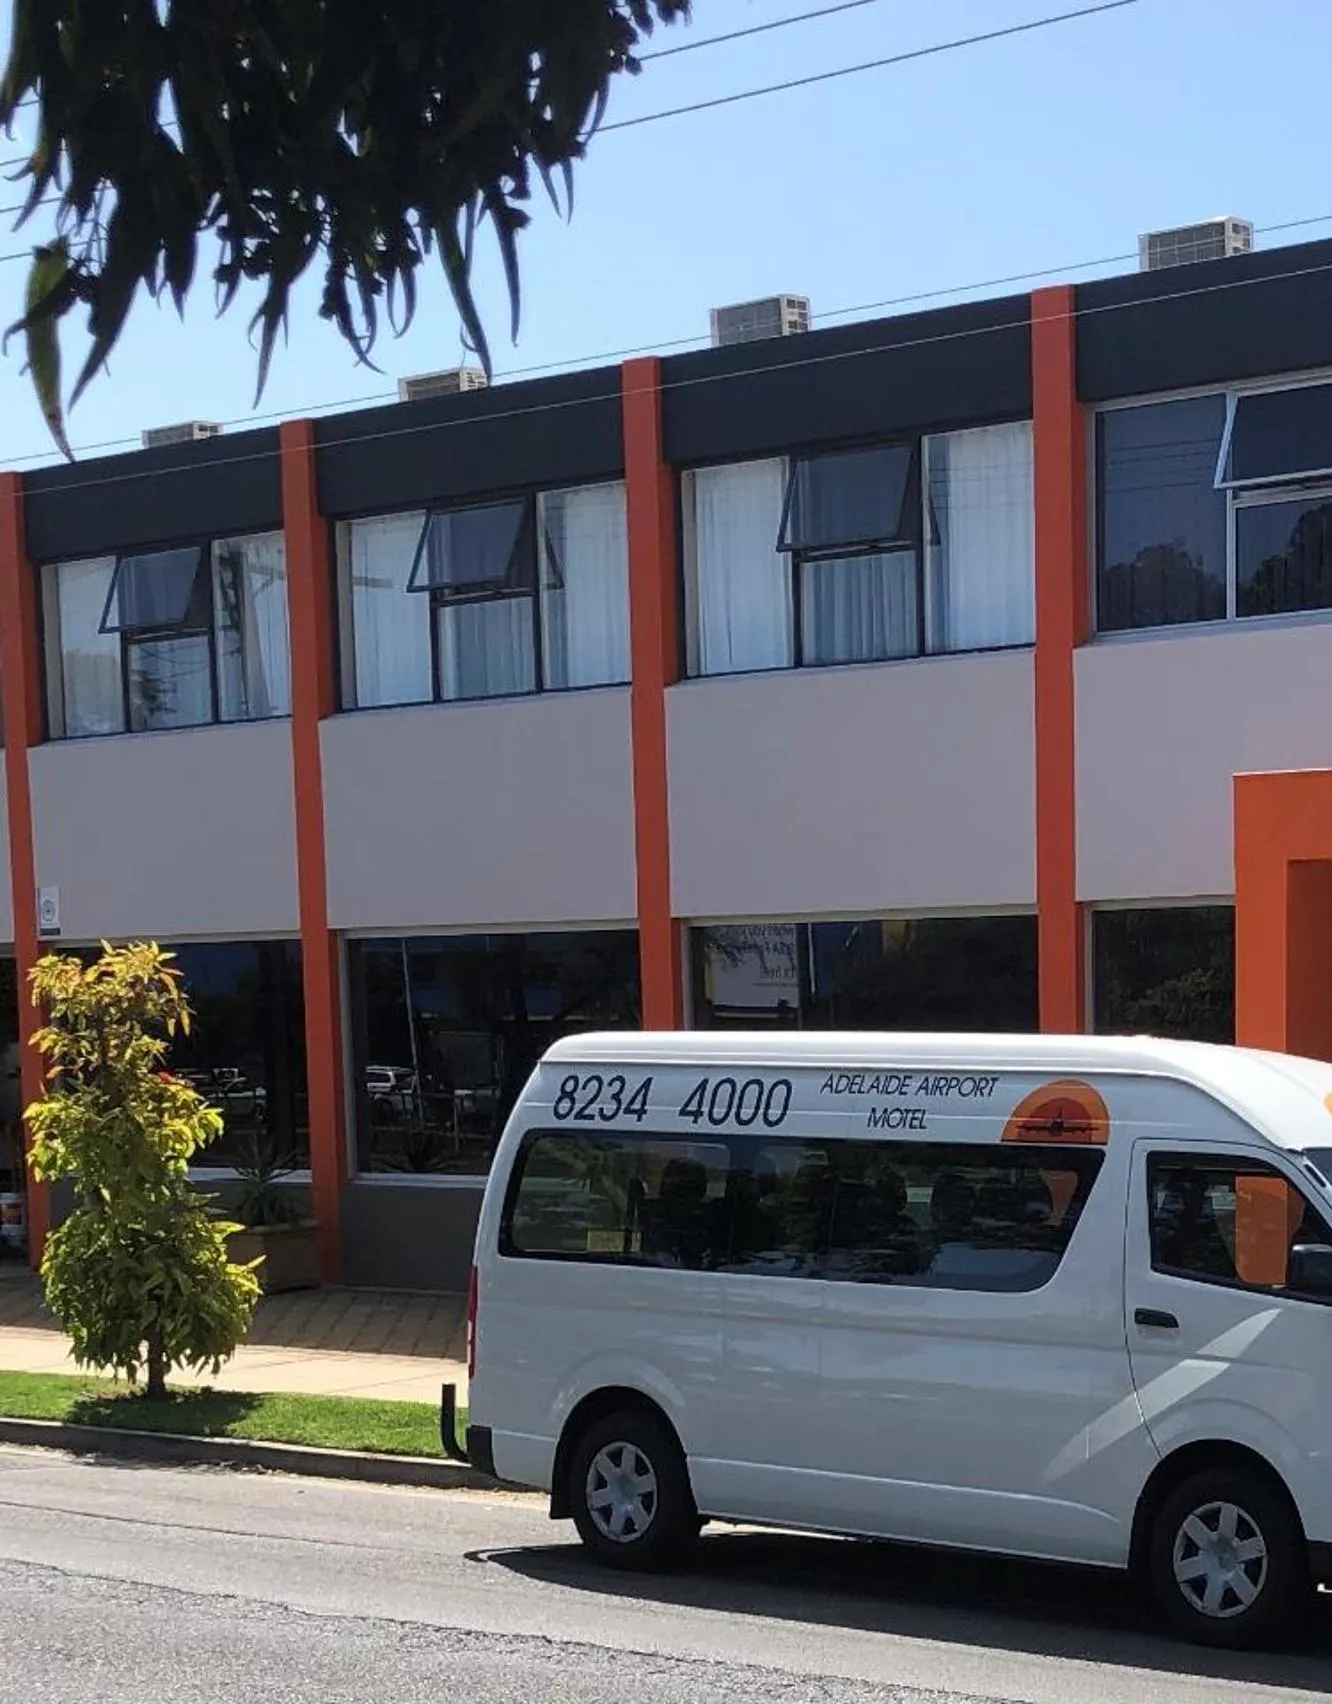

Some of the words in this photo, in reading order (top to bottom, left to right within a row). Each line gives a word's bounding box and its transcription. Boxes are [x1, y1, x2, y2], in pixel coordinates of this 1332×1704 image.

[820, 1073, 912, 1096] ADELAIDE
[914, 1075, 999, 1098] AIRPORT
[552, 1075, 653, 1122] 8234
[678, 1077, 793, 1128] 4000
[866, 1107, 928, 1130] MOTEL
